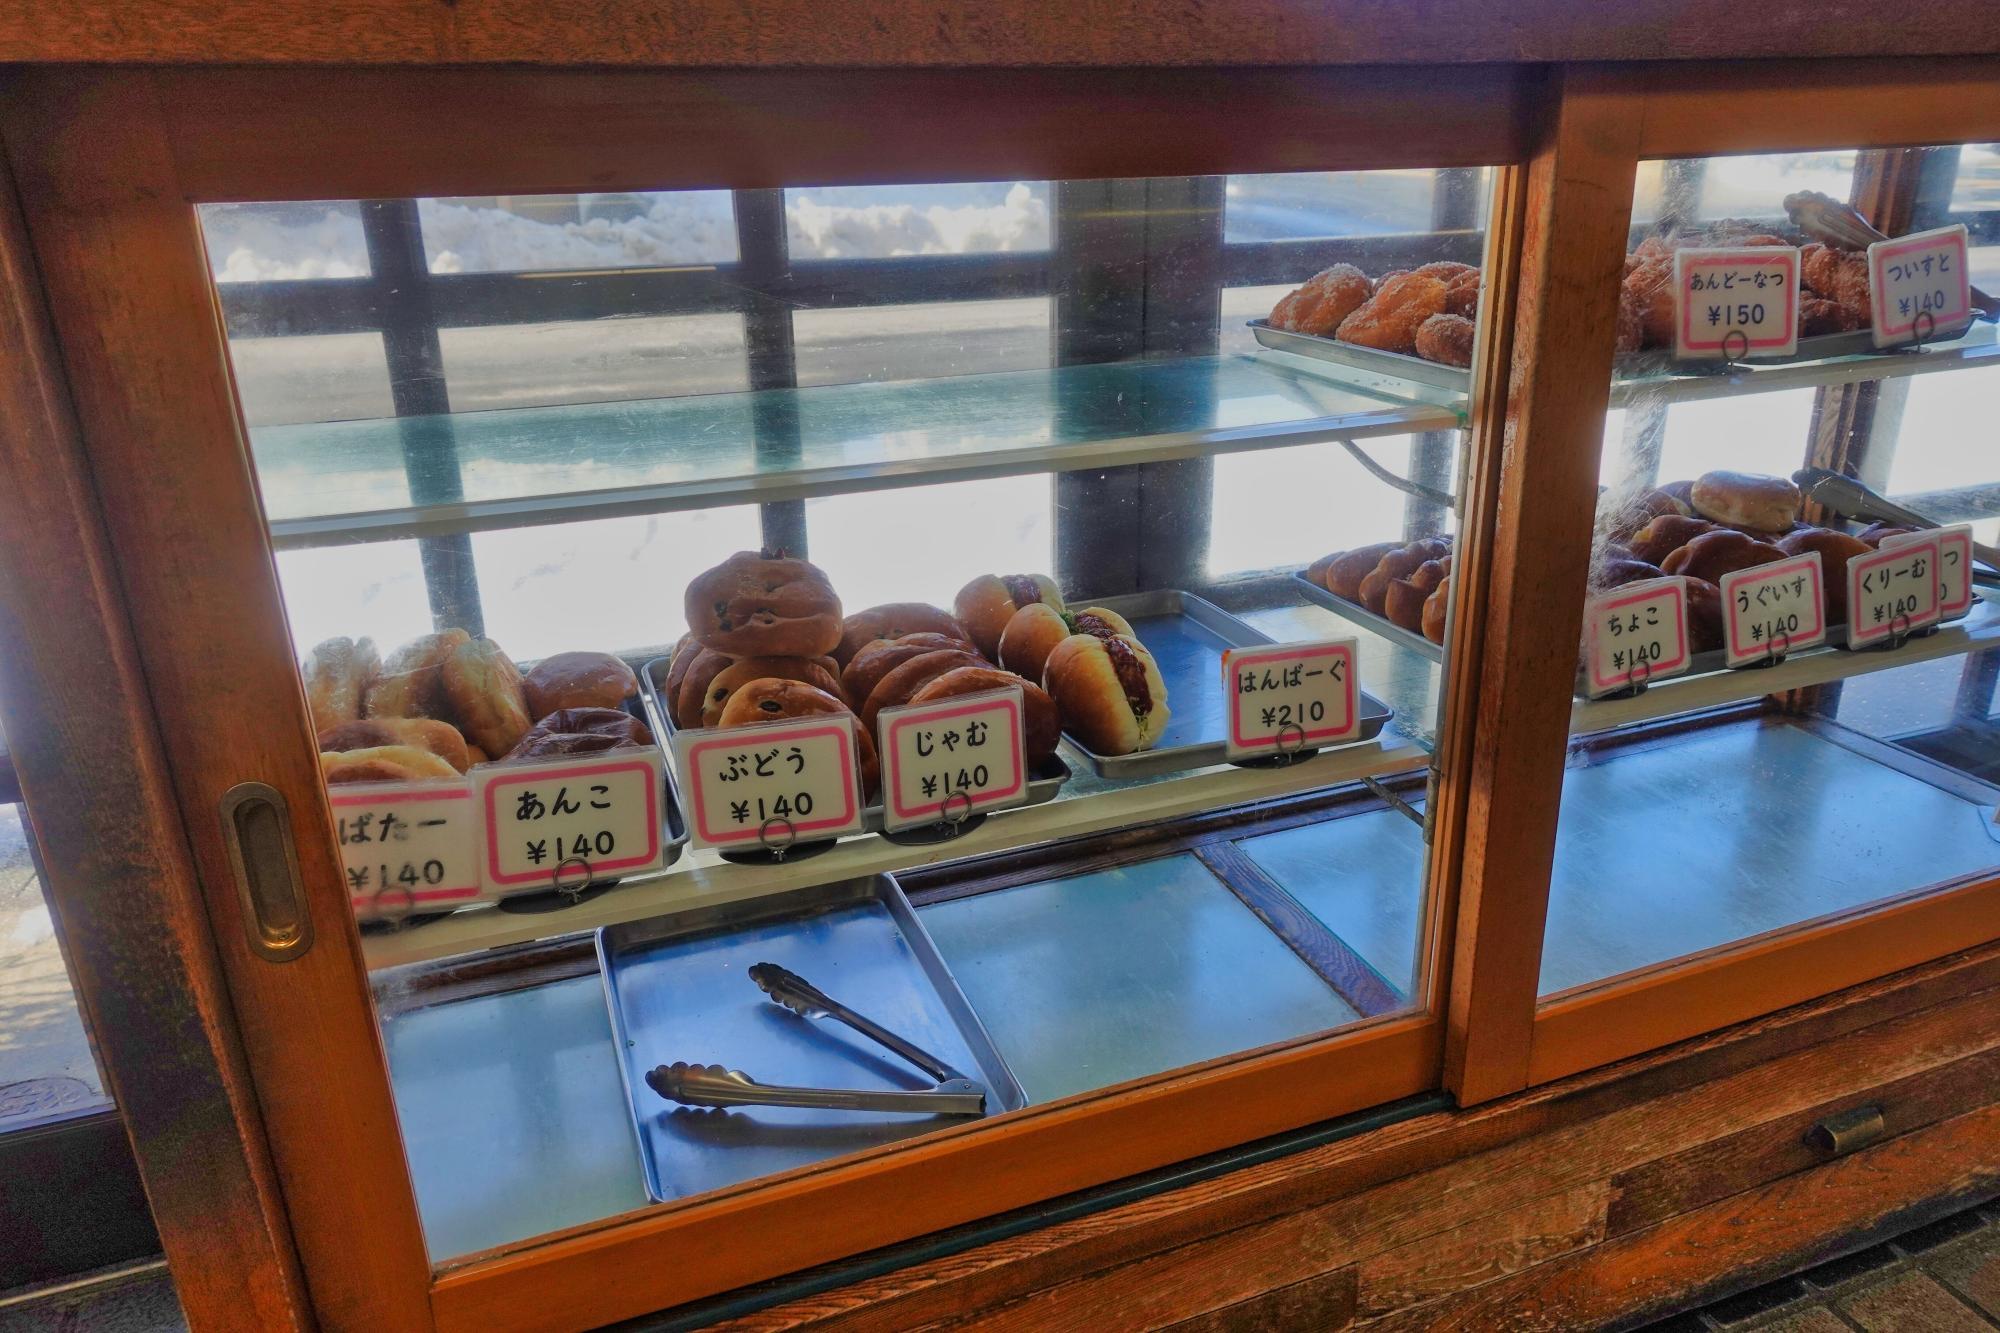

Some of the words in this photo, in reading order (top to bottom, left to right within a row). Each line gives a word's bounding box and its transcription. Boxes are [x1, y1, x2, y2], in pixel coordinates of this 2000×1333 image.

[1690, 270, 1785, 292] あんどーなつ
[1887, 252, 1951, 283] ついすと
[1708, 304, 1765, 326] ¥150
[1898, 289, 1946, 317] ¥140
[1862, 558, 1926, 594] くりーむ
[1737, 575, 1807, 612] うぐいす
[1873, 594, 1918, 623] ¥140
[1607, 605, 1660, 636] ちょこ
[1751, 614, 1799, 642] ¥140
[1612, 641, 1662, 670] ¥140
[1237, 657, 1347, 694] はんばーぐ
[1262, 700, 1325, 727] ¥210
[916, 719, 989, 757] じゃむ
[719, 746, 807, 783] ぶどう
[921, 764, 990, 798] ¥140
[515, 784, 613, 822] あんこ
[730, 791, 814, 824] ¥140
[339, 812, 447, 846] ばたー
[525, 829, 616, 865] ¥140
[347, 858, 446, 891] ¥140
